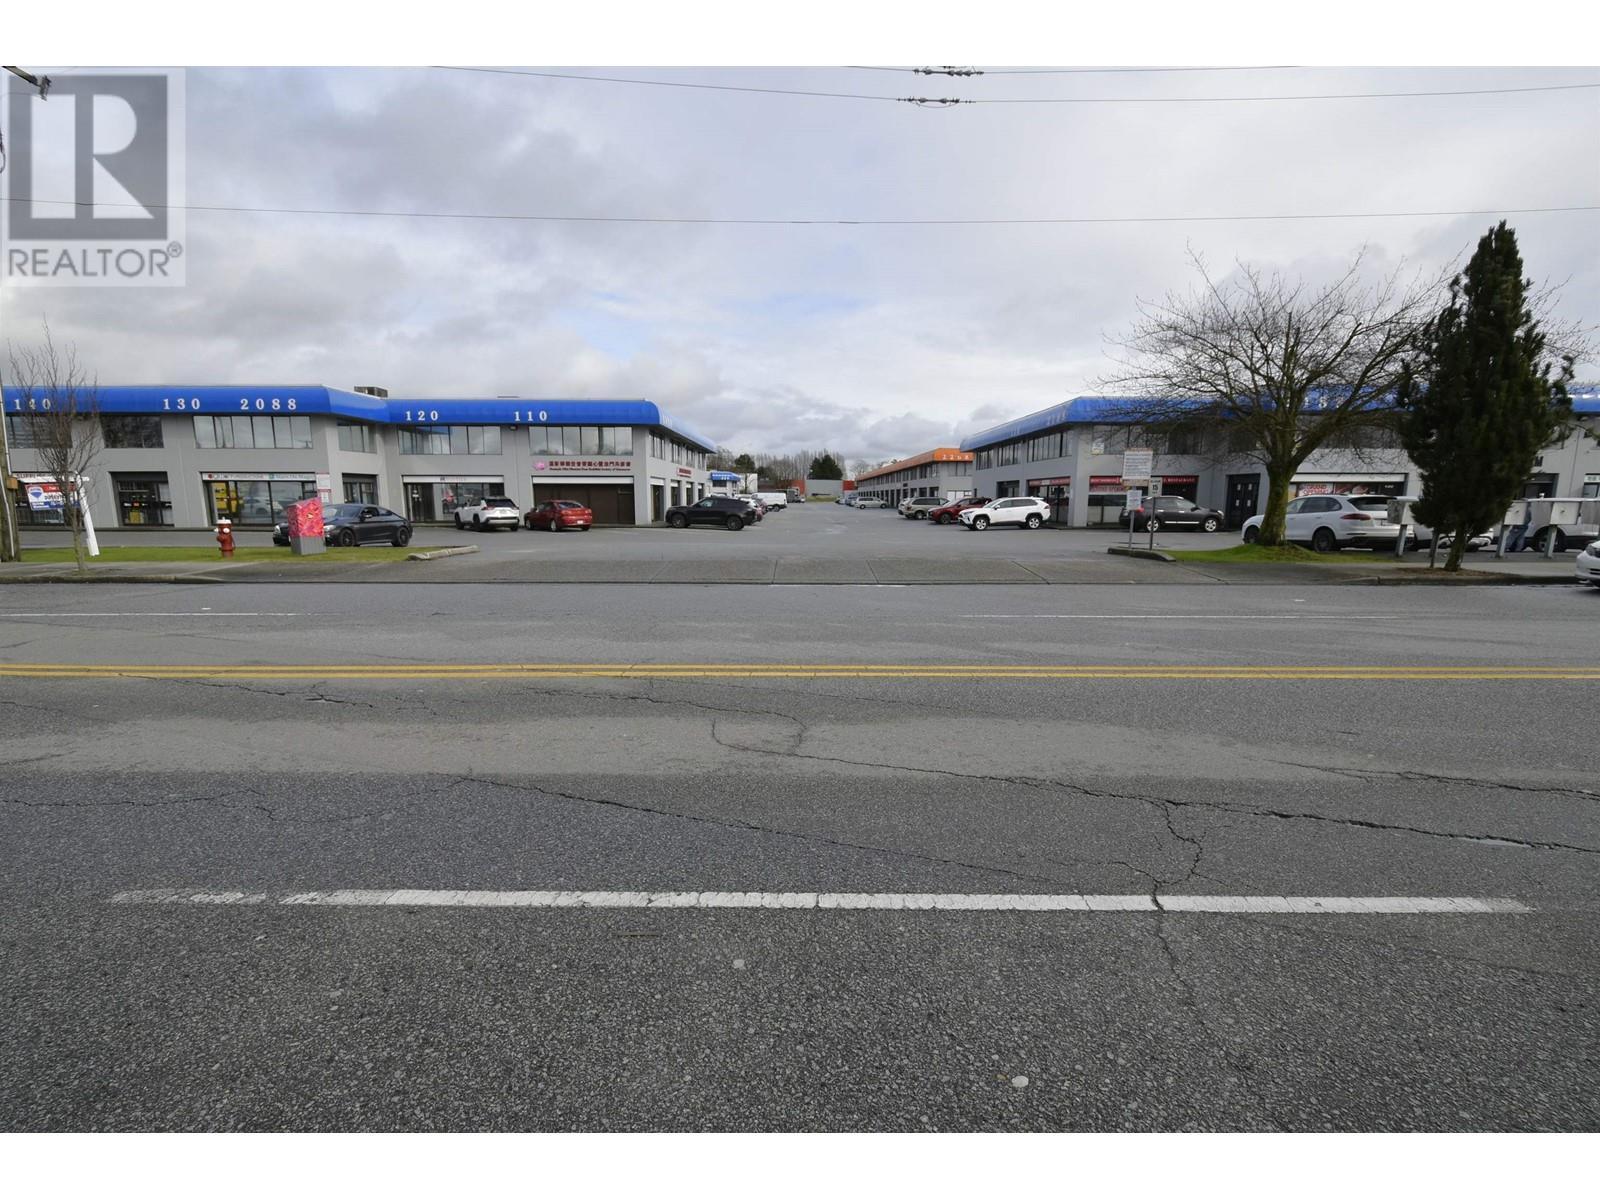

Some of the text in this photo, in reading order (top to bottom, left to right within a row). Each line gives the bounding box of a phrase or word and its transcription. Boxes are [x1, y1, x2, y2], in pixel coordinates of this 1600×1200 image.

[163, 398, 200, 410] 130
[240, 398, 297, 410] 2088
[405, 410, 439, 421] 120
[514, 410, 548, 421] 110
